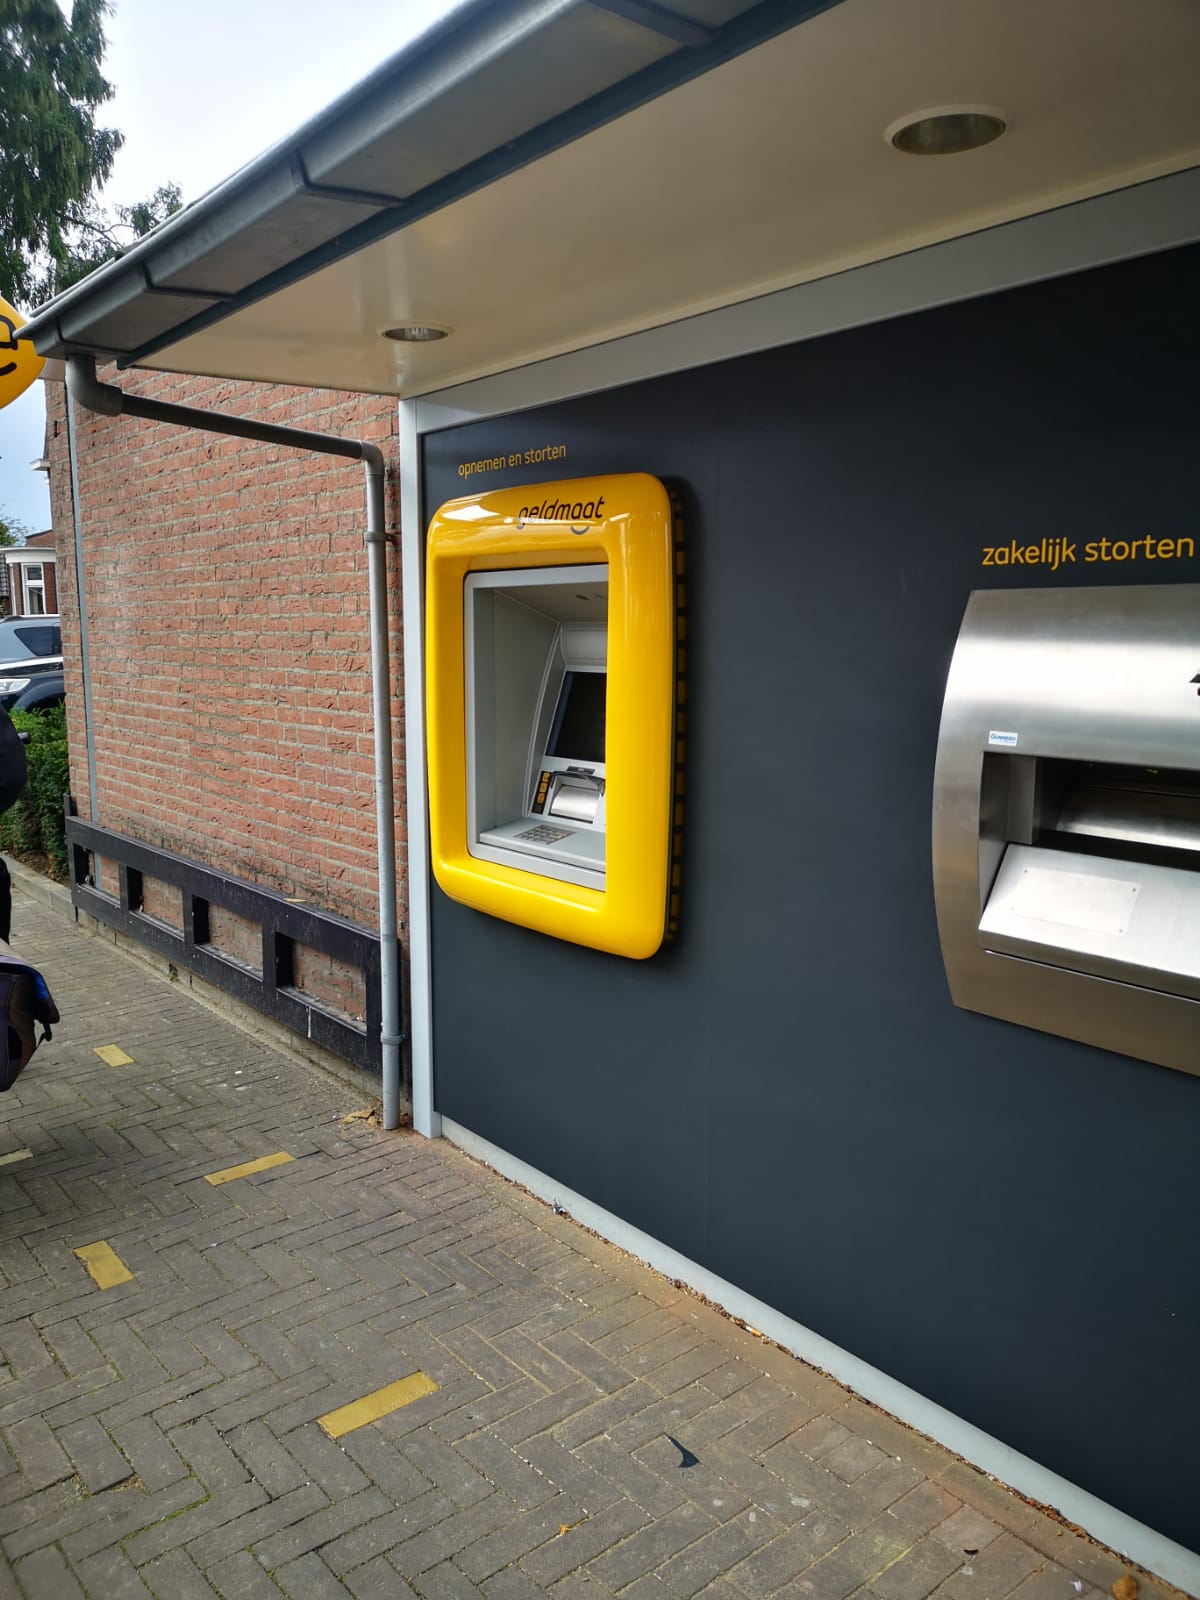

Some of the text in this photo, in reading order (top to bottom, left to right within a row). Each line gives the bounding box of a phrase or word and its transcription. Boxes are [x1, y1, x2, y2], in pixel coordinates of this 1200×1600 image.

[458, 444, 567, 480] opnemen en storten
[516, 496, 605, 530] geldmaat
[981, 534, 1195, 571] zakelijk storten
